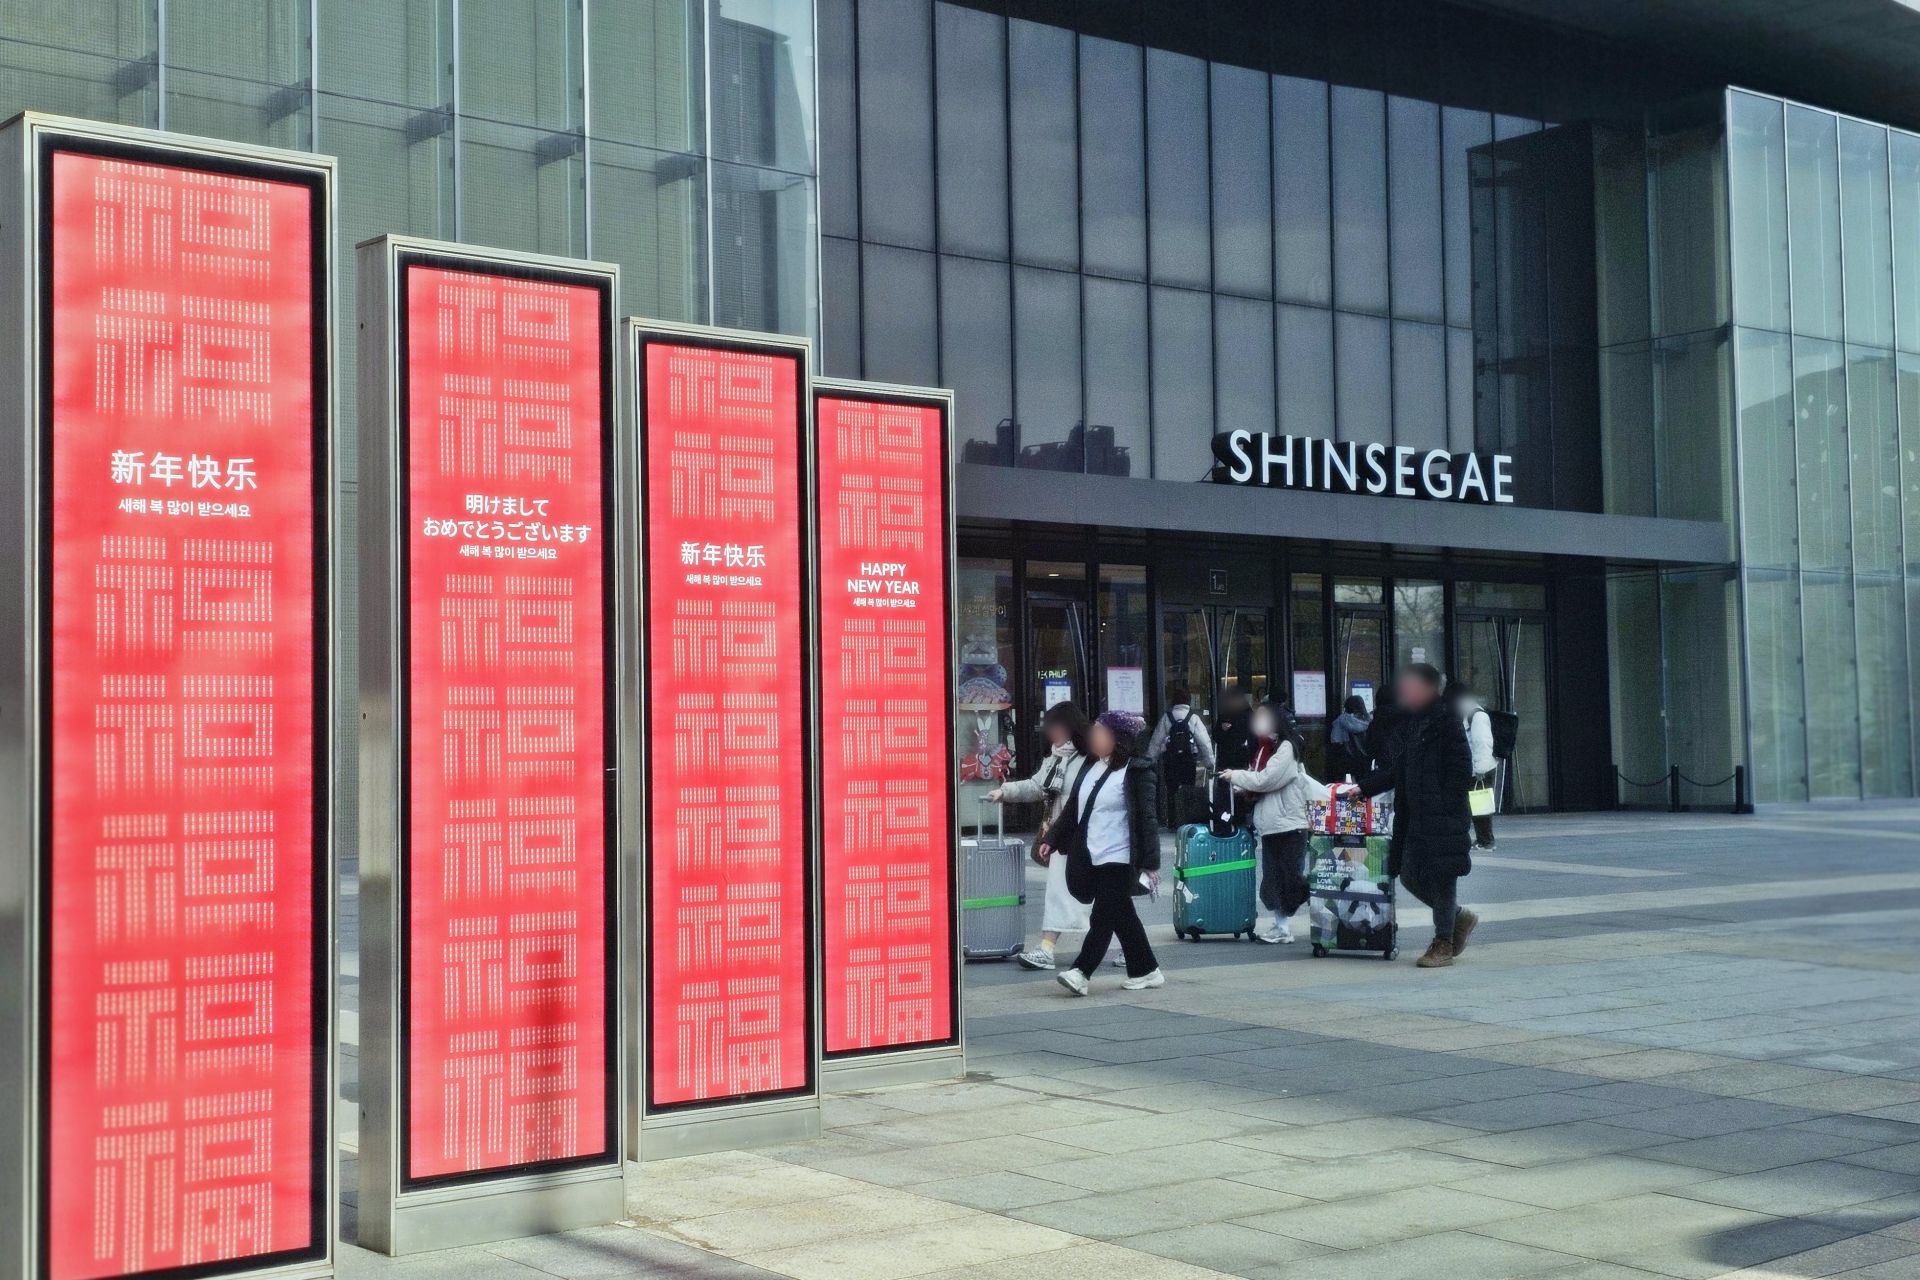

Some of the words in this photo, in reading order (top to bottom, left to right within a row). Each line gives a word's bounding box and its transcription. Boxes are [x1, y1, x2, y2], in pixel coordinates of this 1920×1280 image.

[111, 449, 257, 491] 新年快乐
[1230, 429, 1514, 503] SHINSEGAE
[118, 498, 147, 514] 새해
[150, 500, 164, 515] 복
[167, 501, 194, 516] 많이
[197, 502, 251, 518] 받으세요
[465, 494, 549, 517] 明けまして
[423, 515, 592, 543] おめでとうございます
[459, 544, 480, 557] 새해
[482, 546, 493, 558] 복
[494, 546, 515, 559] 많이
[517, 547, 558, 560] 받으세요
[681, 541, 766, 568] 新年快乐
[861, 562, 907, 577] HAPPY
[685, 574, 702, 585] 새해
[703, 575, 711, 585] 복
[712, 575, 728, 586] 많이
[730, 576, 763, 587] 받으세요
[847, 579, 882, 593] NEW
[885, 580, 920, 595] YEAR
[853, 597, 867, 607] 새해
[890, 599, 916, 608] 받으세요
